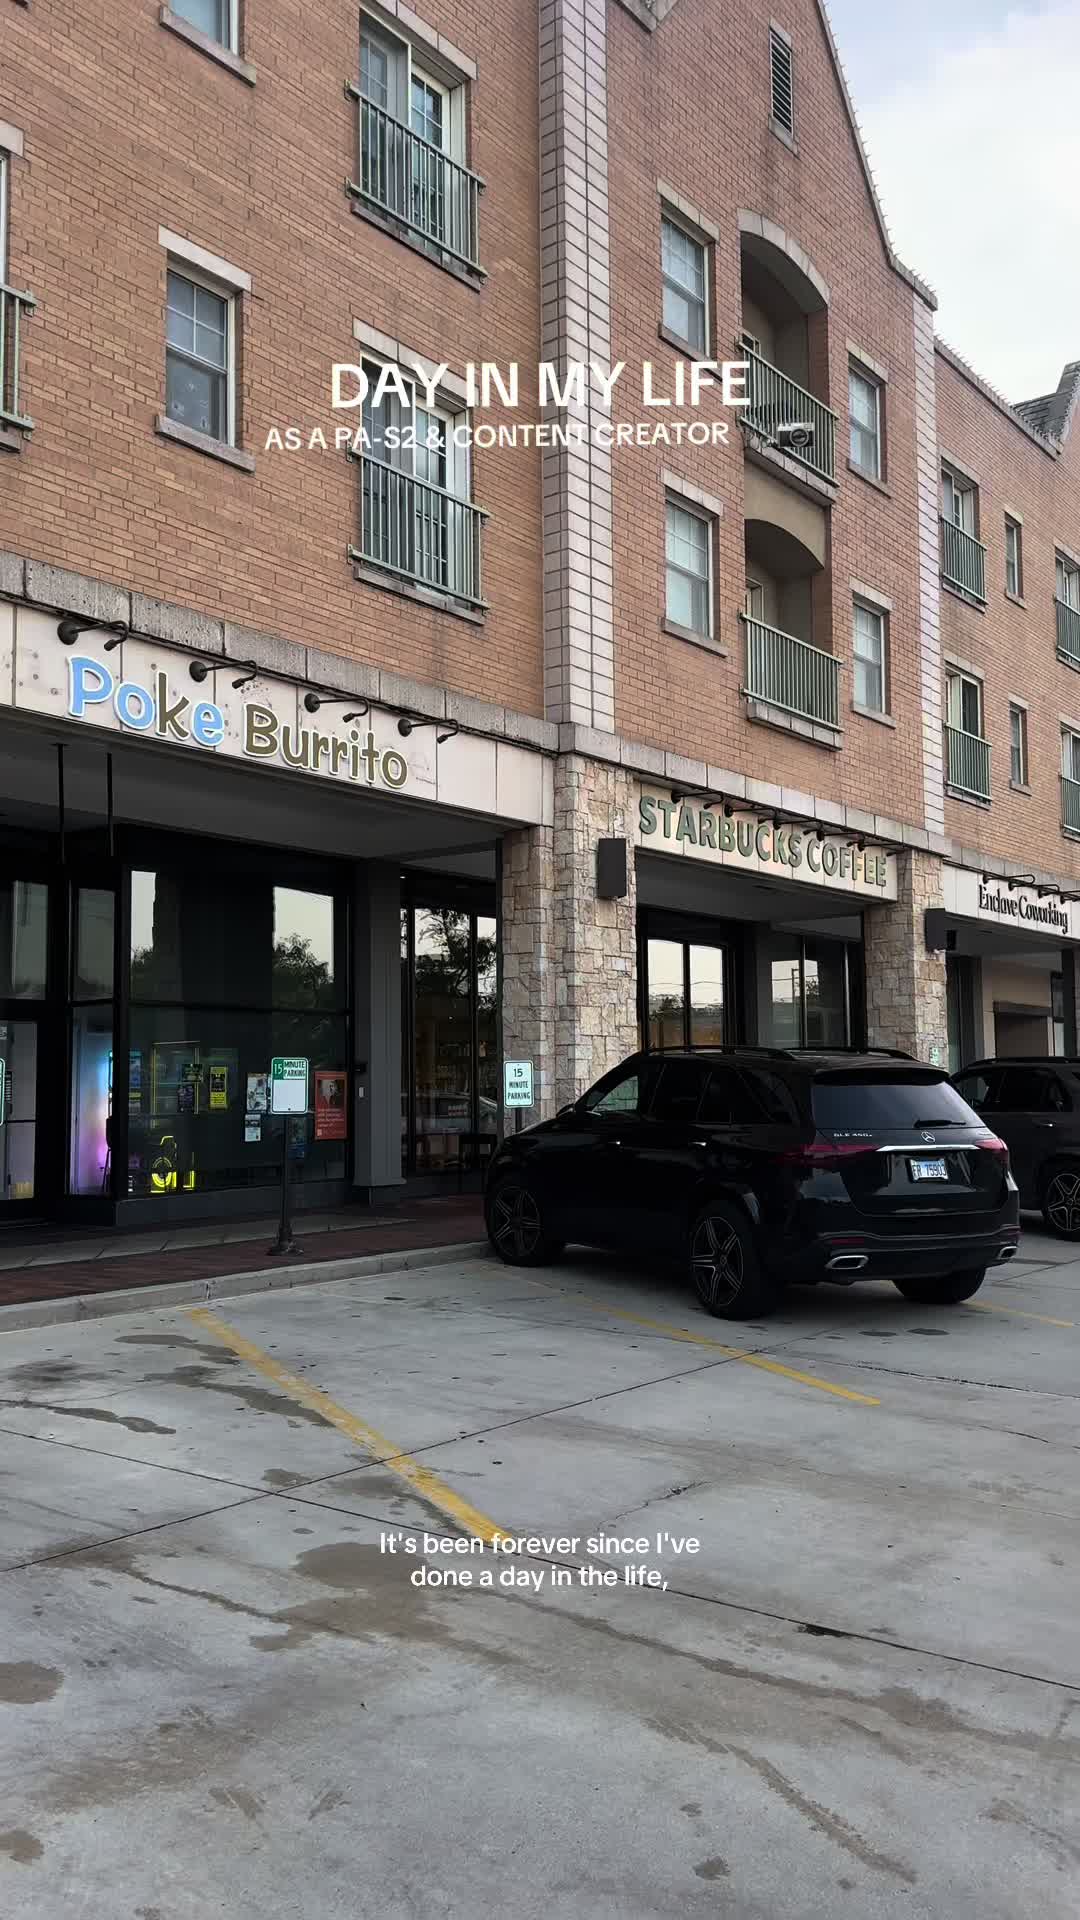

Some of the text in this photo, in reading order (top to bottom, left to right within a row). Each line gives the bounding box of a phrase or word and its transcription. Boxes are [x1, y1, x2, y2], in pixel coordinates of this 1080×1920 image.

[67, 655, 409, 788] Poke Burrito
[638, 796, 888, 888] STARBUCKS COFFEE
[979, 884, 1068, 935] Enclave Coworking
[273, 1063, 283, 1075] 15
[284, 1060, 305, 1068] MINUTE
[284, 1069, 305, 1077] PARKING
[513, 1068, 523, 1077] 15
